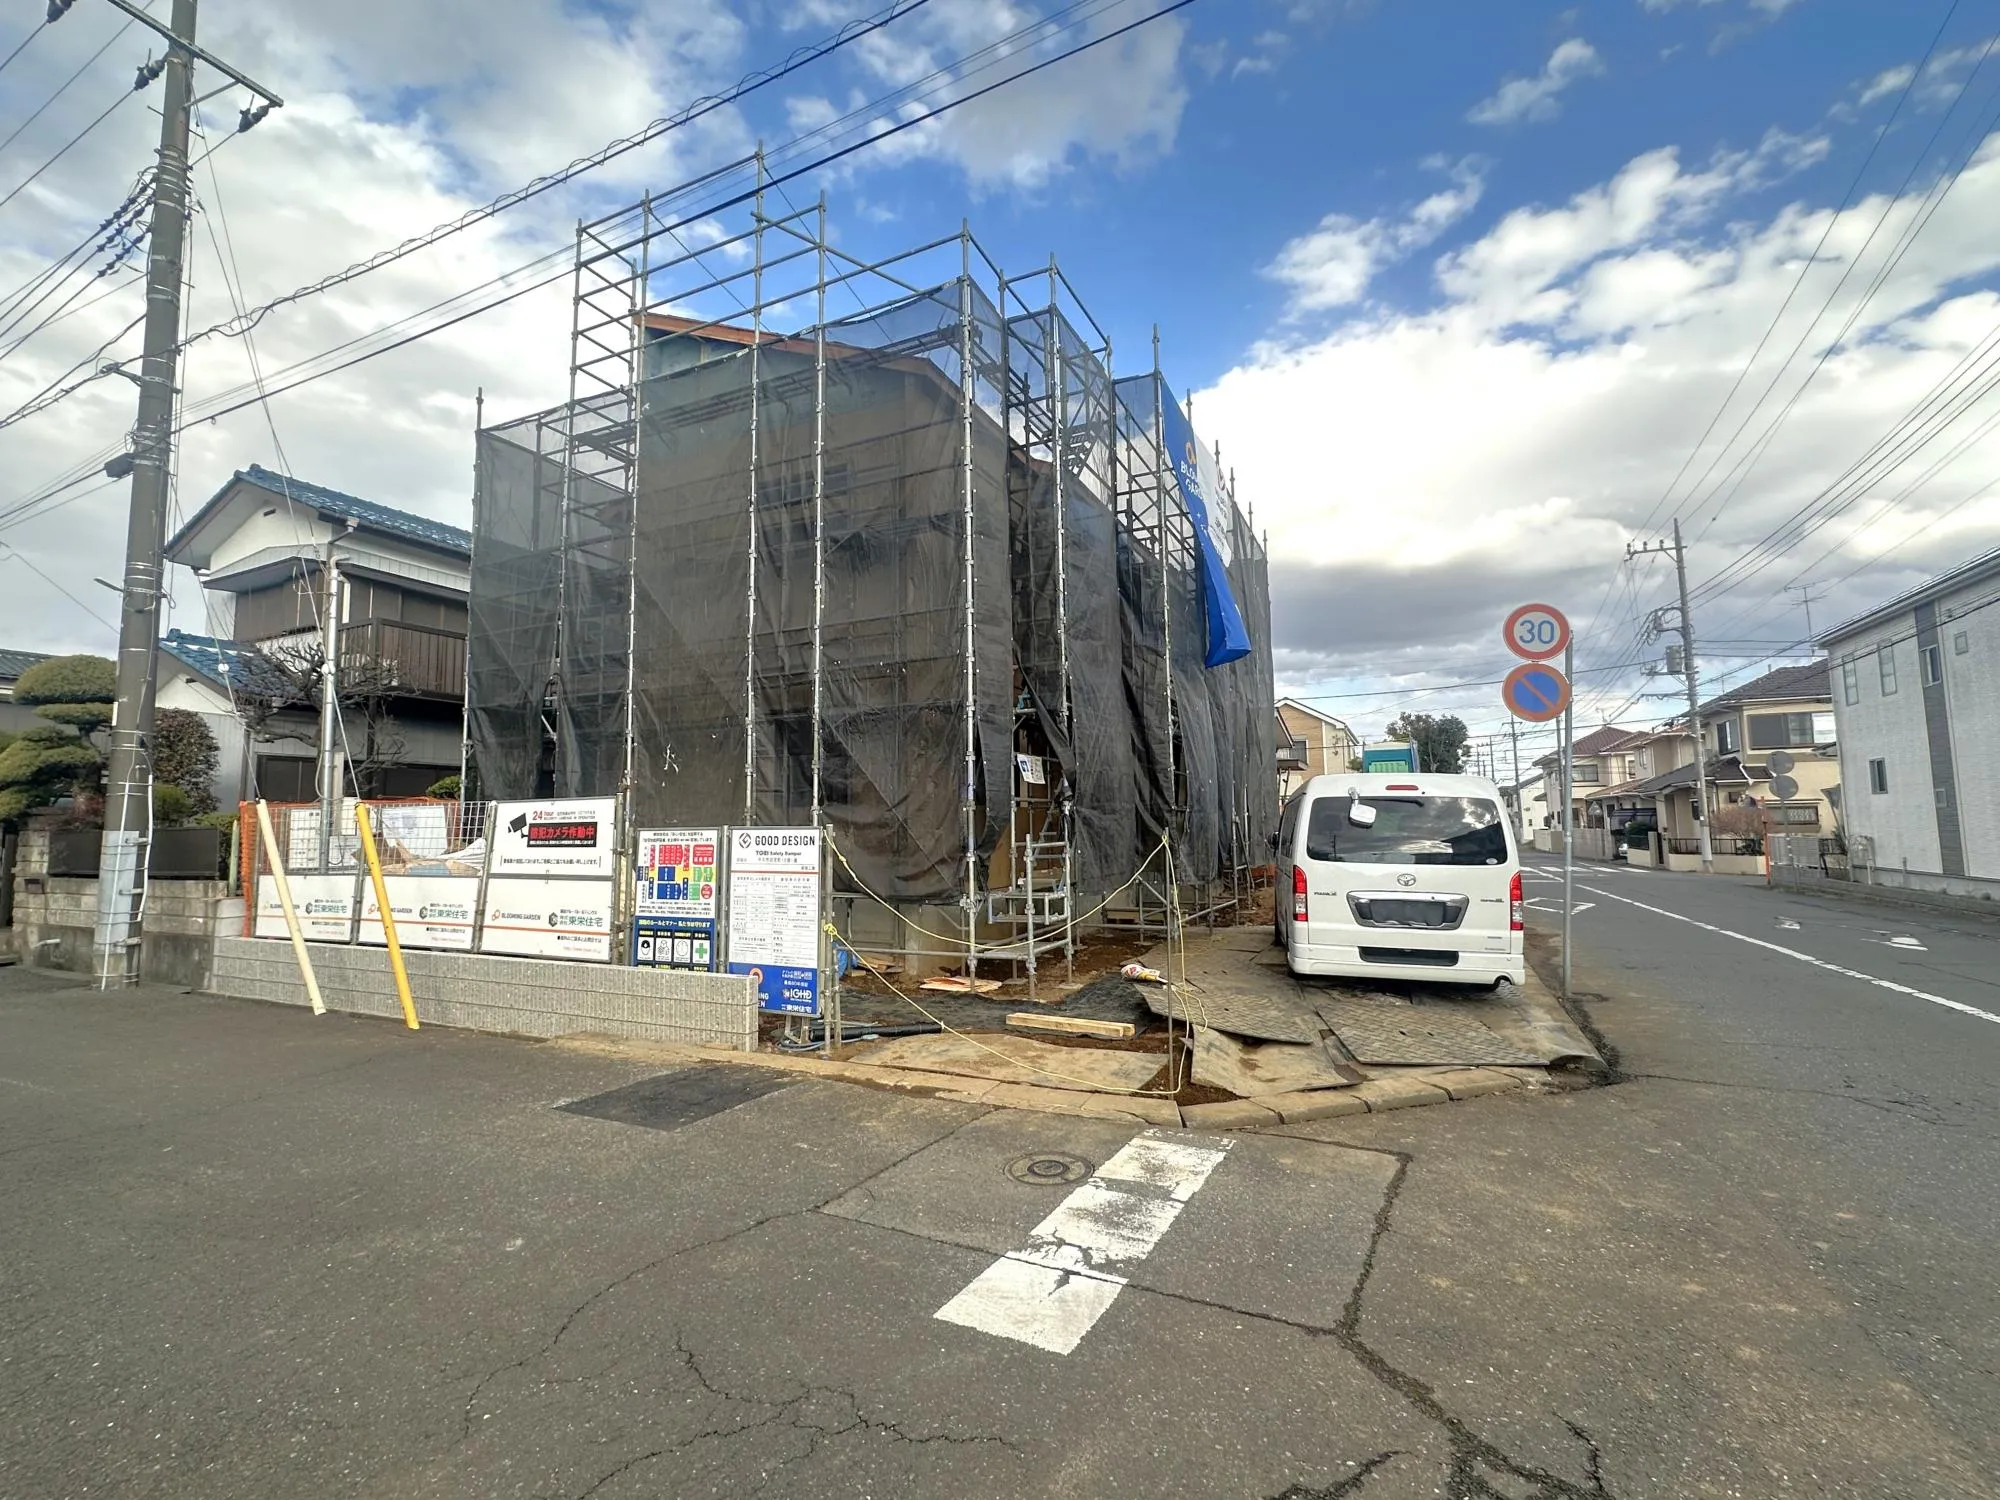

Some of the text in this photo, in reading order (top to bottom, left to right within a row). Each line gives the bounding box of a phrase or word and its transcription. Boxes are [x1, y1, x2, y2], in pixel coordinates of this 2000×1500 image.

[1519, 619, 1555, 645] 30
[532, 810, 543, 821] 24
[530, 826, 595, 839] 防犯カメラ作動中
[755, 835, 815, 846] GOOD DESIGN
[568, 916, 603, 927] 東栄住宅
